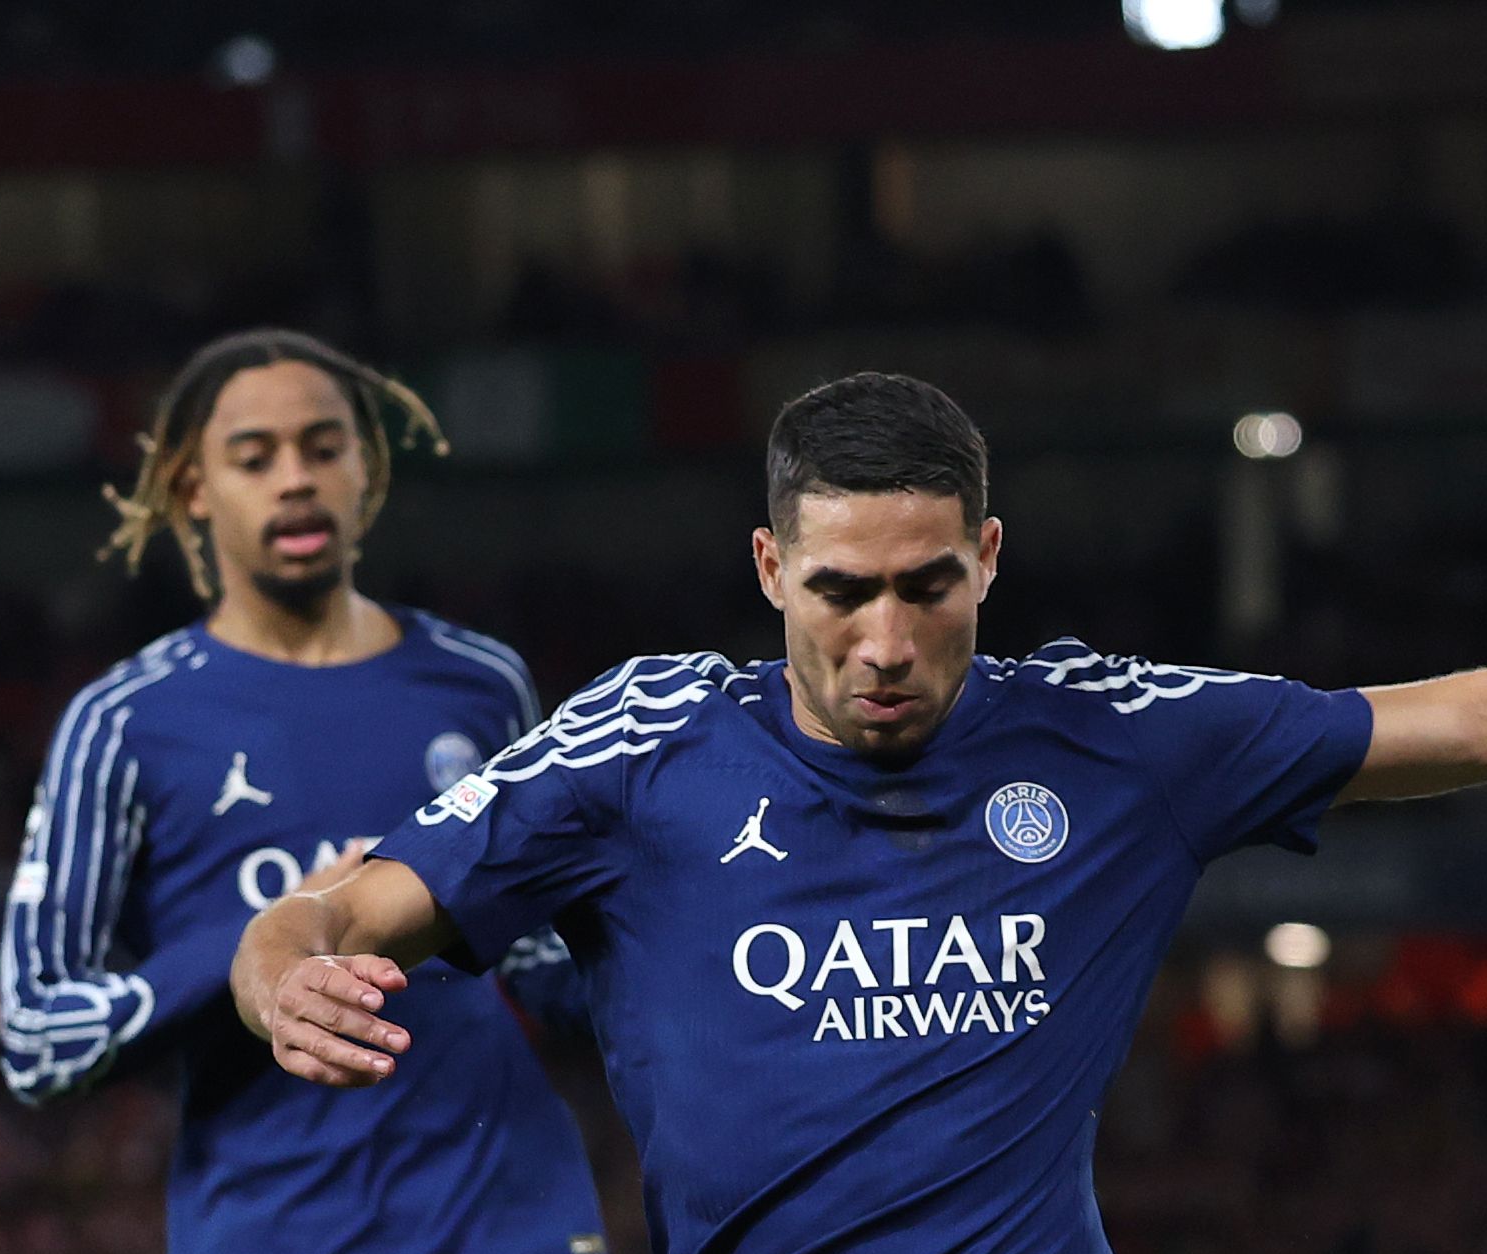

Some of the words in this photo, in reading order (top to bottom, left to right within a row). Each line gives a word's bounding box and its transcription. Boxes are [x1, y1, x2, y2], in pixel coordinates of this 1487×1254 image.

[996, 786, 1050, 807] PARIS
[733, 913, 1046, 1012] QATAR
[813, 989, 1051, 1041] AIRWAYS
